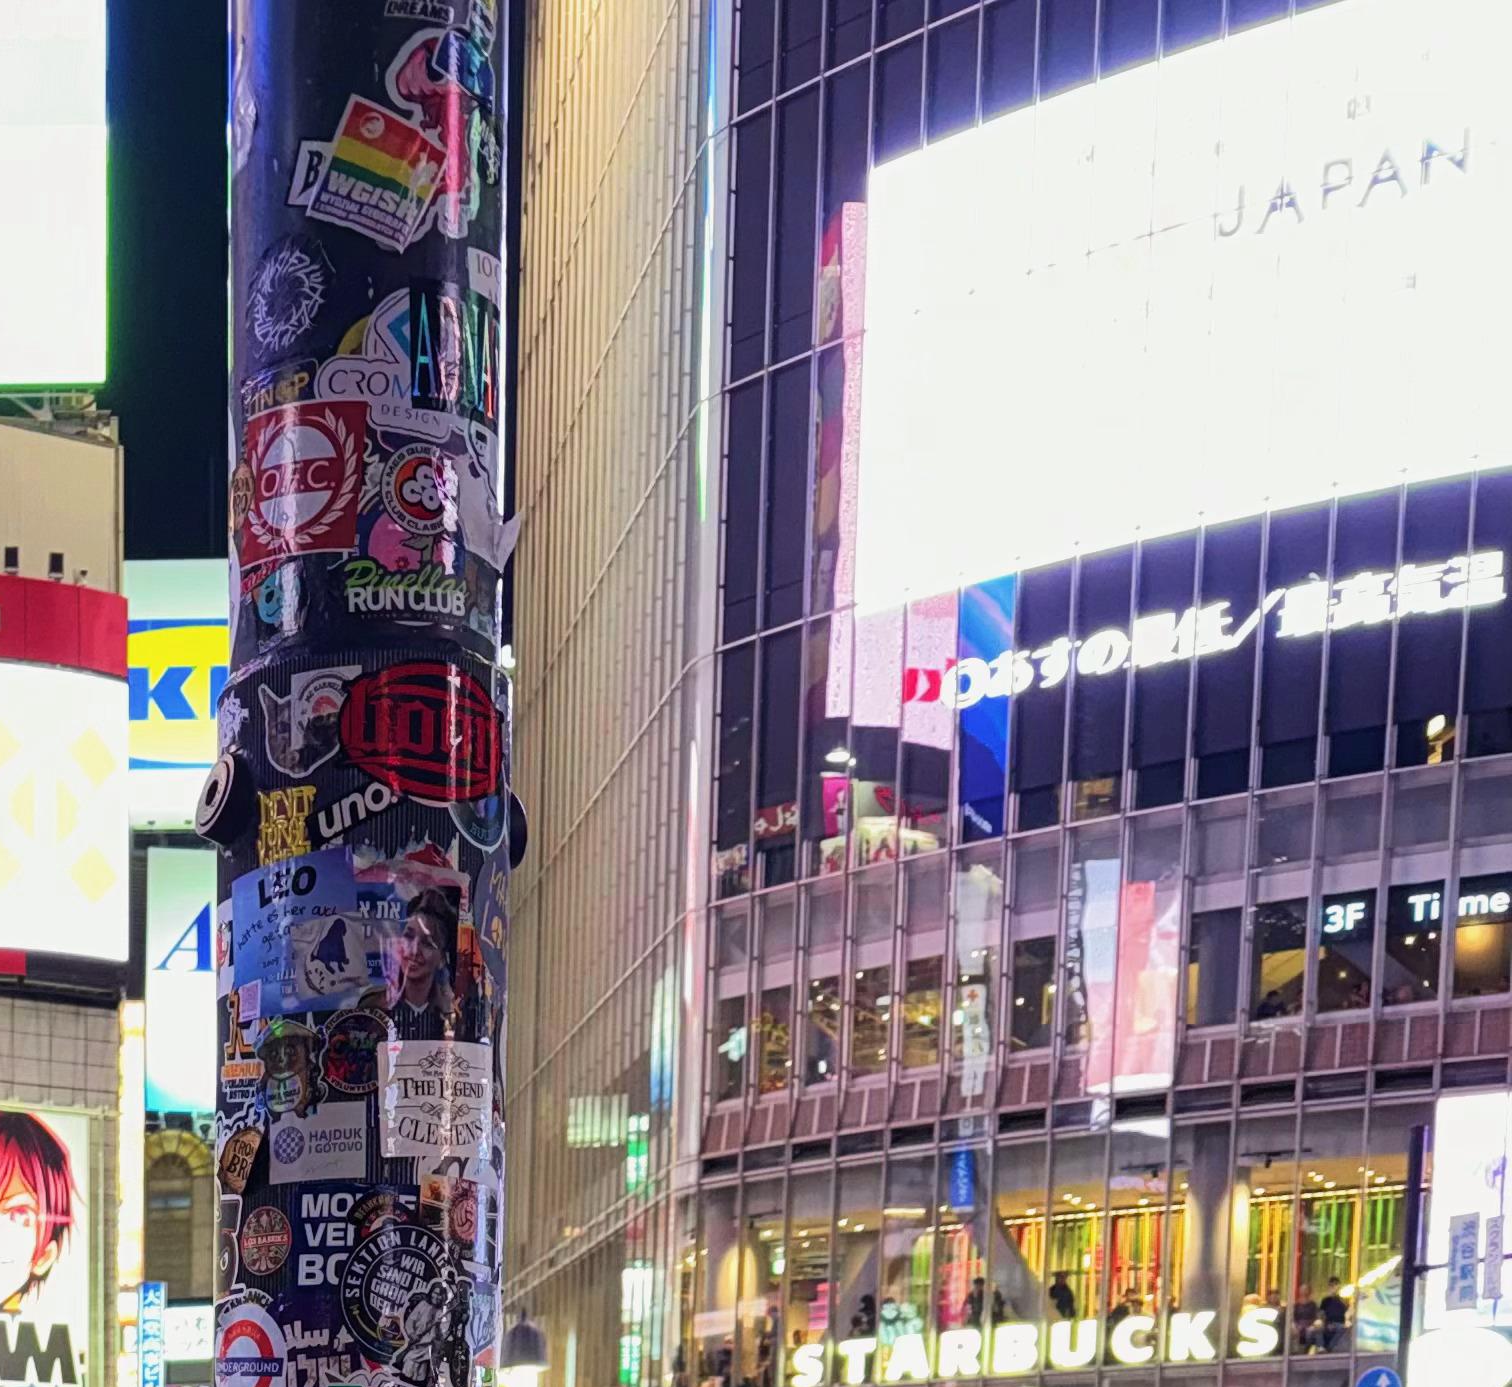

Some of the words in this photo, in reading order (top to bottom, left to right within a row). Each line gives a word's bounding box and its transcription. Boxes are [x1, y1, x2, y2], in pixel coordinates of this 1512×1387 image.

[1217, 127, 1472, 238] JAPAN
[347, 587, 405, 613] RUN
[407, 588, 467, 617] CLUB
[1323, 903, 1366, 935] 3F
[397, 1076, 436, 1099] THE
[308, 1126, 363, 1142] HAJDUK
[315, 1141, 364, 1155] GOTOVO
